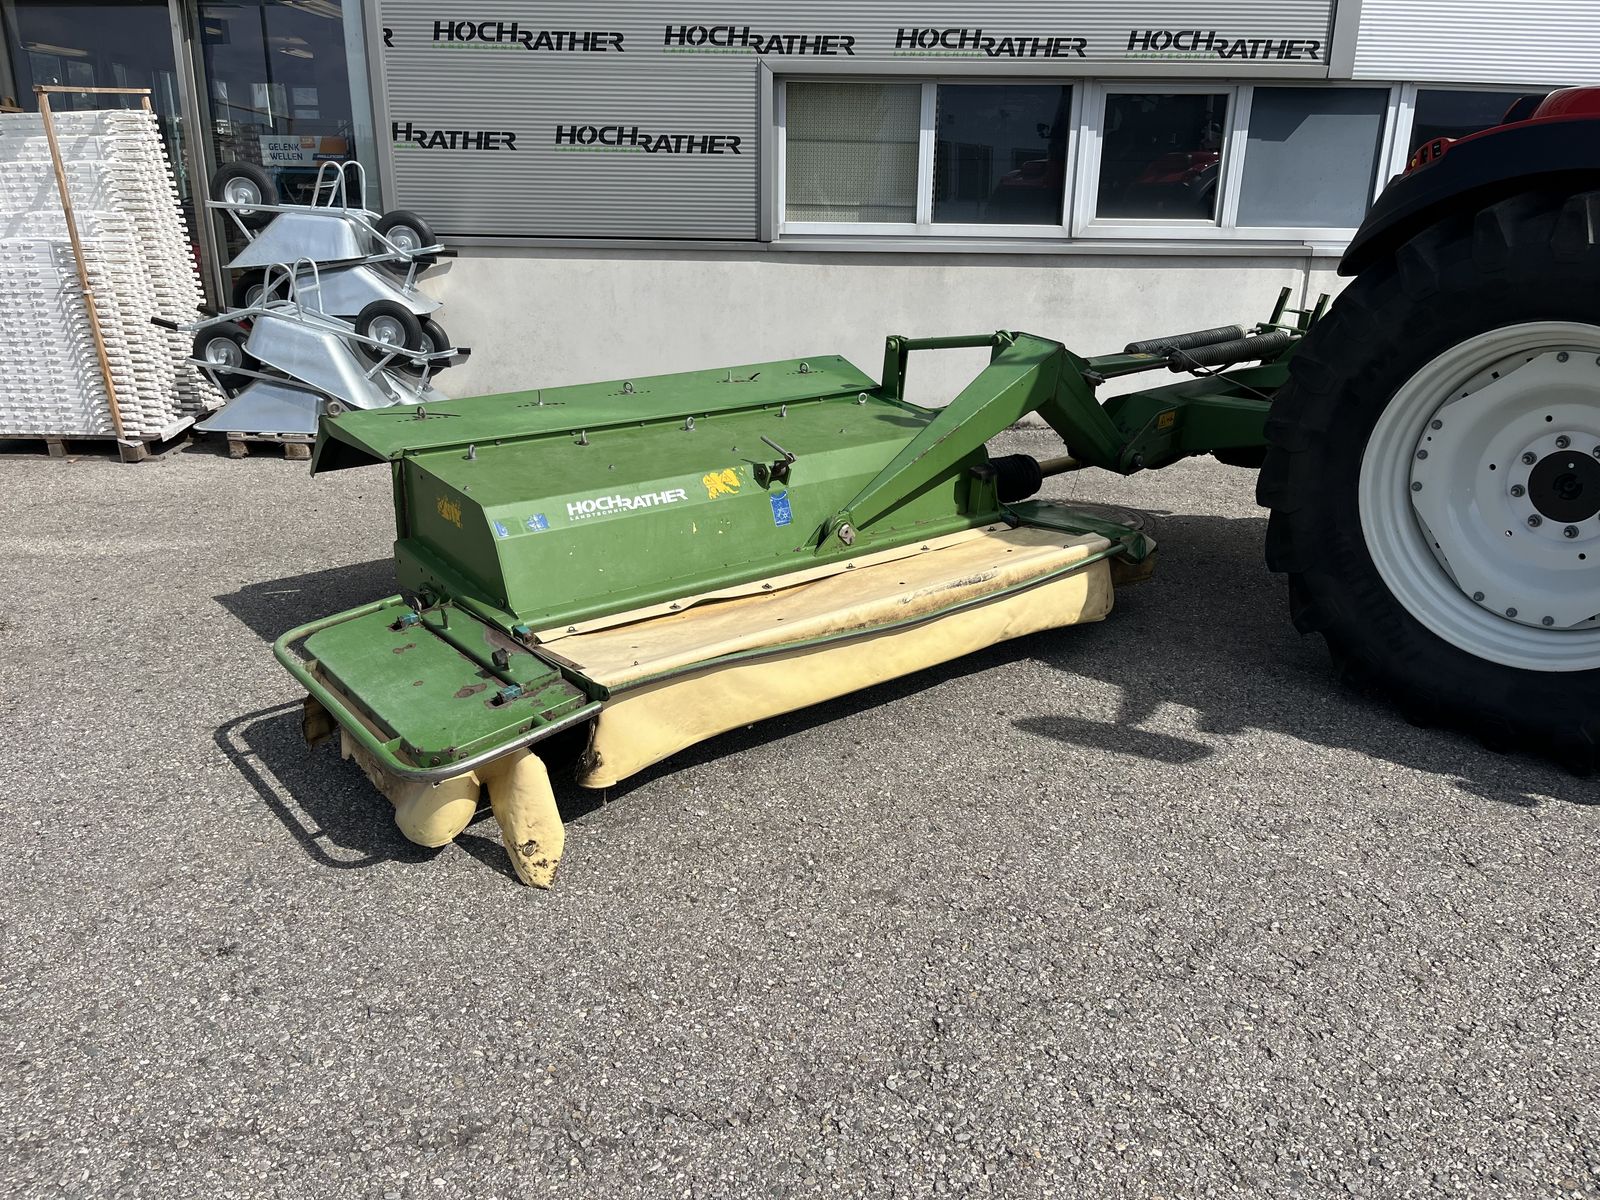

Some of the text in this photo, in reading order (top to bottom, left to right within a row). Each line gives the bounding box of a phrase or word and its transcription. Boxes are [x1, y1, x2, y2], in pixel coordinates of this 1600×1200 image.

[433, 21, 625, 52] HOCHRATHER
[664, 25, 856, 56] HOCHRATHER
[895, 28, 1087, 58] HOCHRATHER
[1127, 30, 1321, 60] HOCHRATHER
[268, 143, 300, 152] GELENK
[555, 125, 742, 155] HOCHRATHER
[269, 153, 304, 161] WELLEN
[567, 488, 688, 516] HOCHRATHER
[569, 507, 628, 521] LANDTECHNIK
